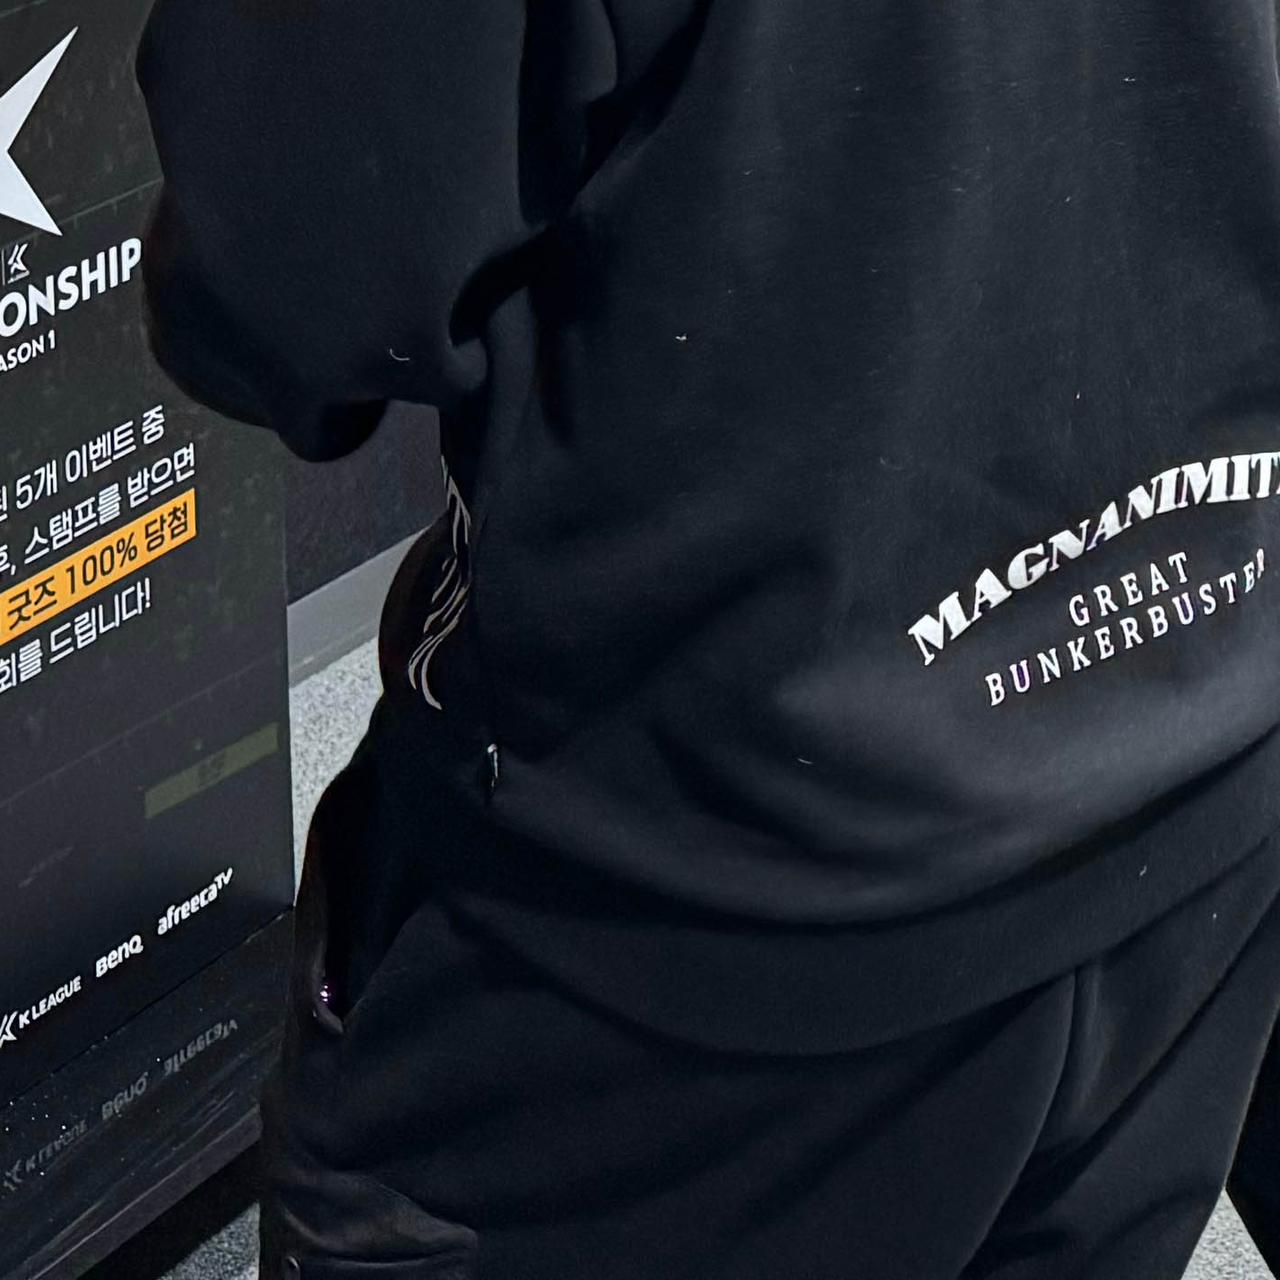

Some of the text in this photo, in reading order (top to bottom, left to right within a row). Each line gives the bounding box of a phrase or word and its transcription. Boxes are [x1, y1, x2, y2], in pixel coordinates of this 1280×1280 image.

[49, 329, 57, 351] 1
[16, 458, 58, 510] 5개
[65, 420, 136, 483] 이벤트
[141, 404, 166, 444] 중
[24, 482, 121, 565] 스탬프를
[126, 441, 196, 508] 받으면
[8, 576, 58, 630] 굿즈
[66, 531, 138, 591] 100%
[144, 501, 190, 553] 당첨
[1068, 551, 1189, 627] GREAT
[48, 577, 152, 664] 드립니다!
[984, 548, 1265, 707] BUNKERBUSTER
[31, 976, 83, 1022] LEAGUE
